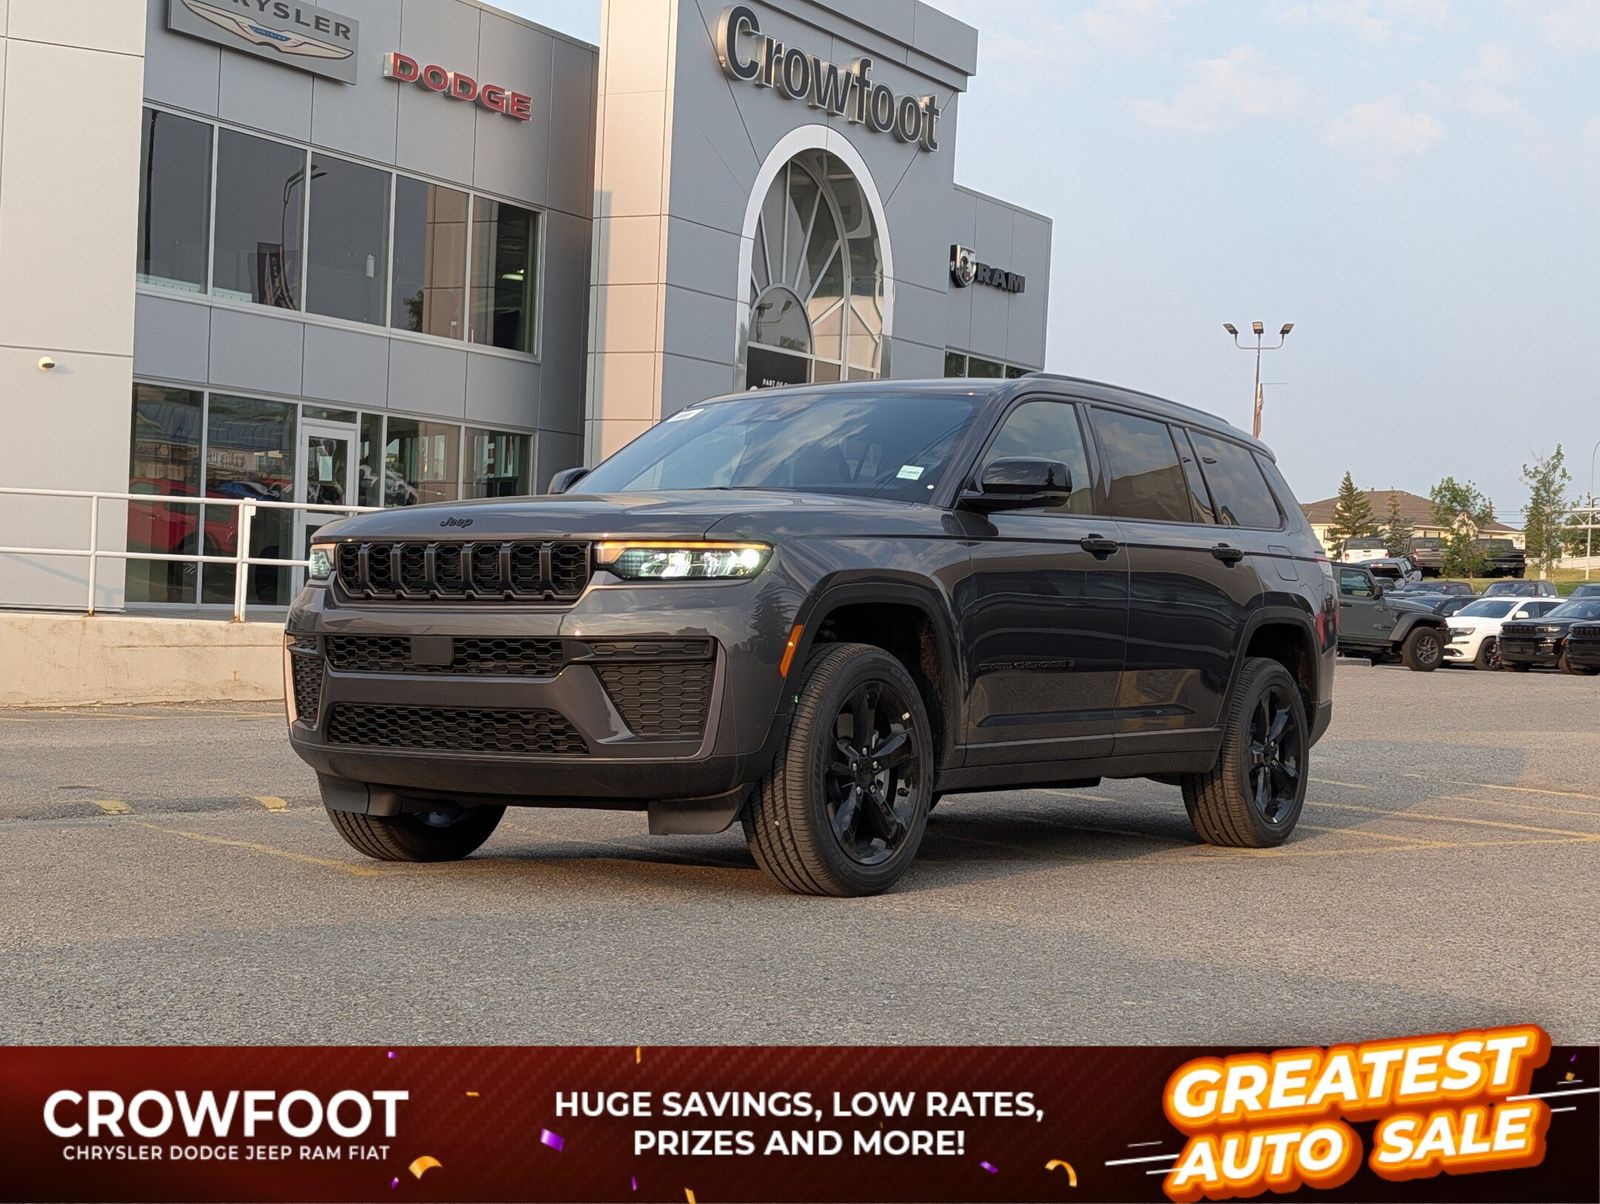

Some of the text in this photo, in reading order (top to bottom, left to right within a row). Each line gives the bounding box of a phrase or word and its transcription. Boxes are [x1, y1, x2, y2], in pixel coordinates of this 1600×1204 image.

[385, 51, 533, 122] DODGE
[717, 4, 941, 152] Crowfoot
[976, 262, 1025, 293] RAM
[440, 516, 473, 528] Jeep
